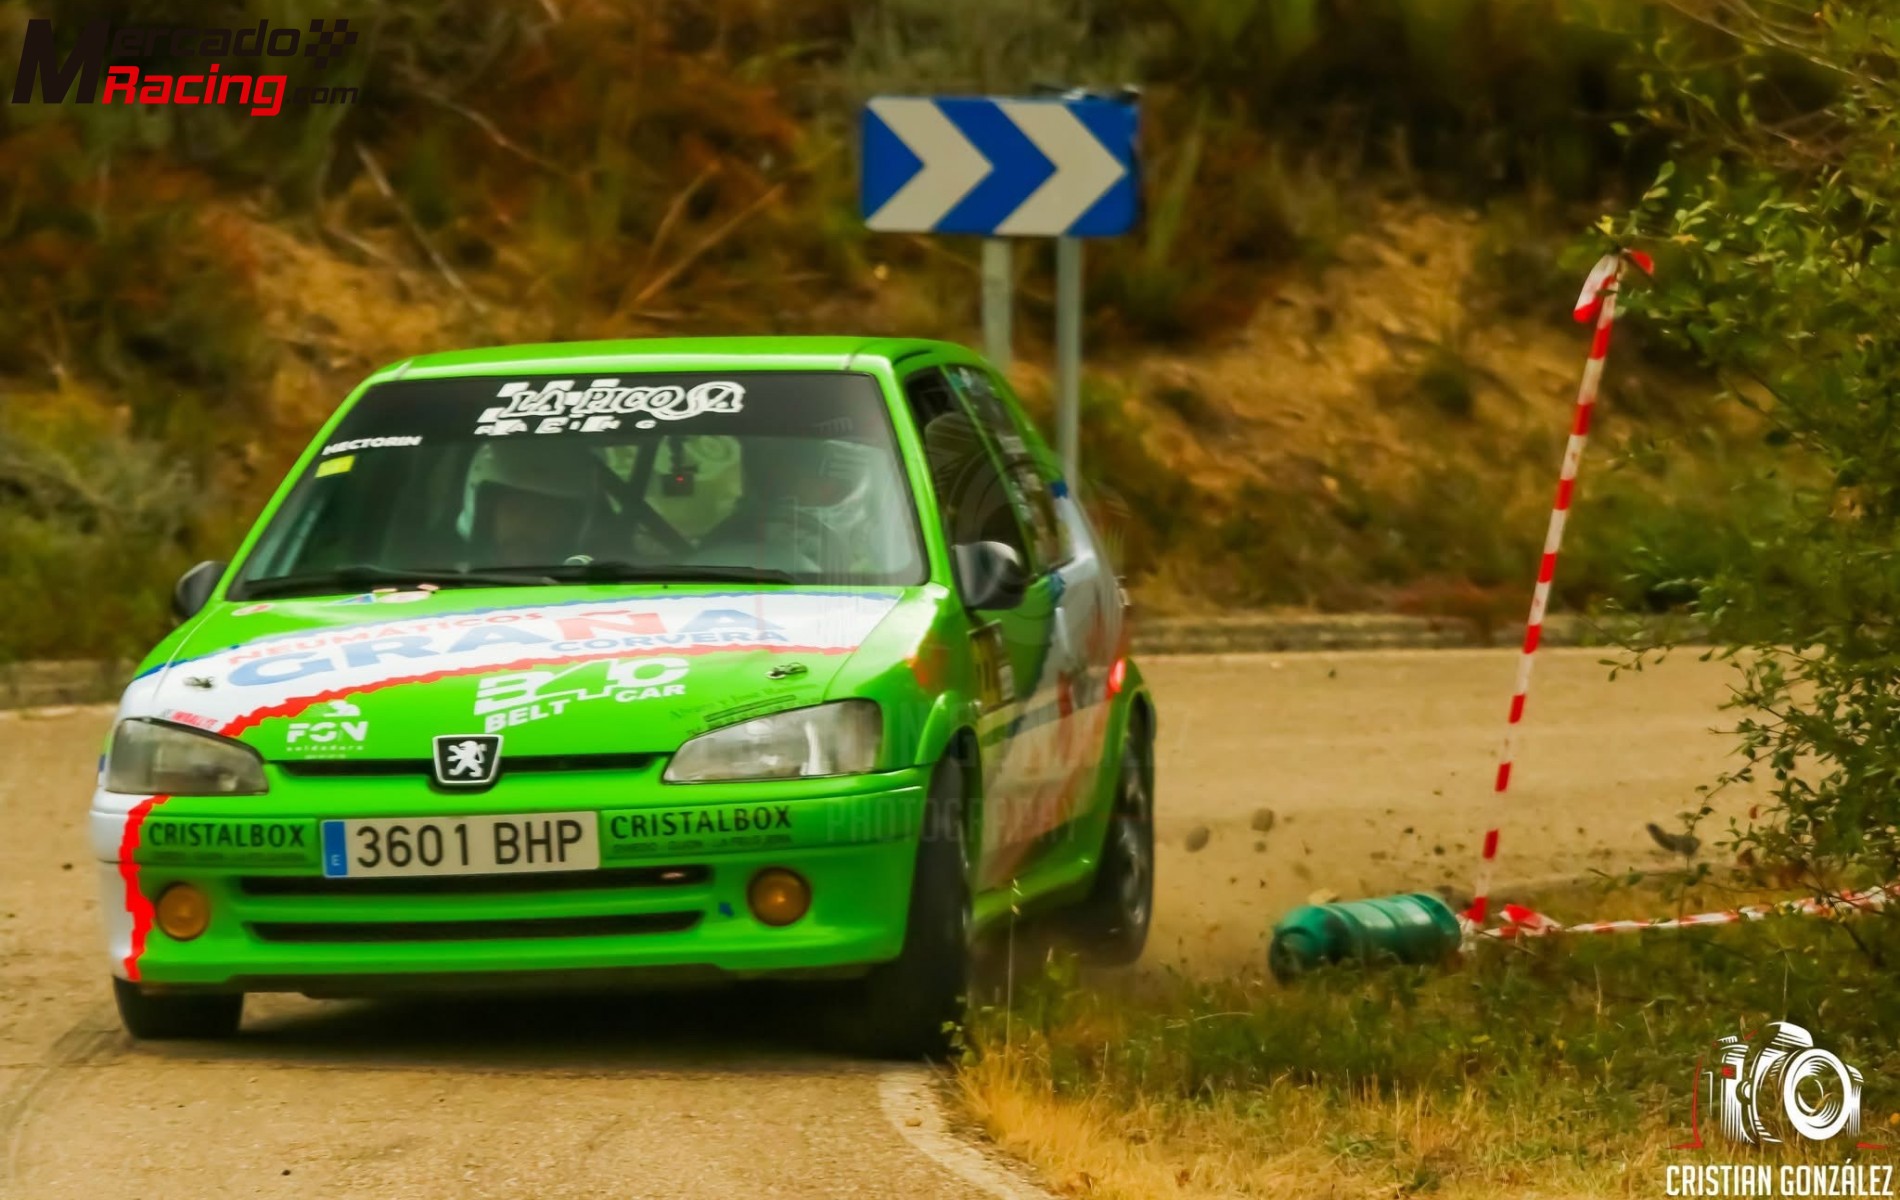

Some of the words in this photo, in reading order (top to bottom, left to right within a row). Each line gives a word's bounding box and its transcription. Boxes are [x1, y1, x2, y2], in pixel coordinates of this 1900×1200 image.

[228, 609, 787, 687] GRAÑA
[550, 630, 789, 652] CORVERA
[484, 699, 571, 734] BELT
[615, 684, 686, 703] CAR
[148, 822, 305, 848] CRISTALBOX
[610, 806, 791, 840] CRISTALBOX
[331, 854, 341, 867] E
[356, 823, 470, 869] 3601
[493, 819, 583, 866] BHP
